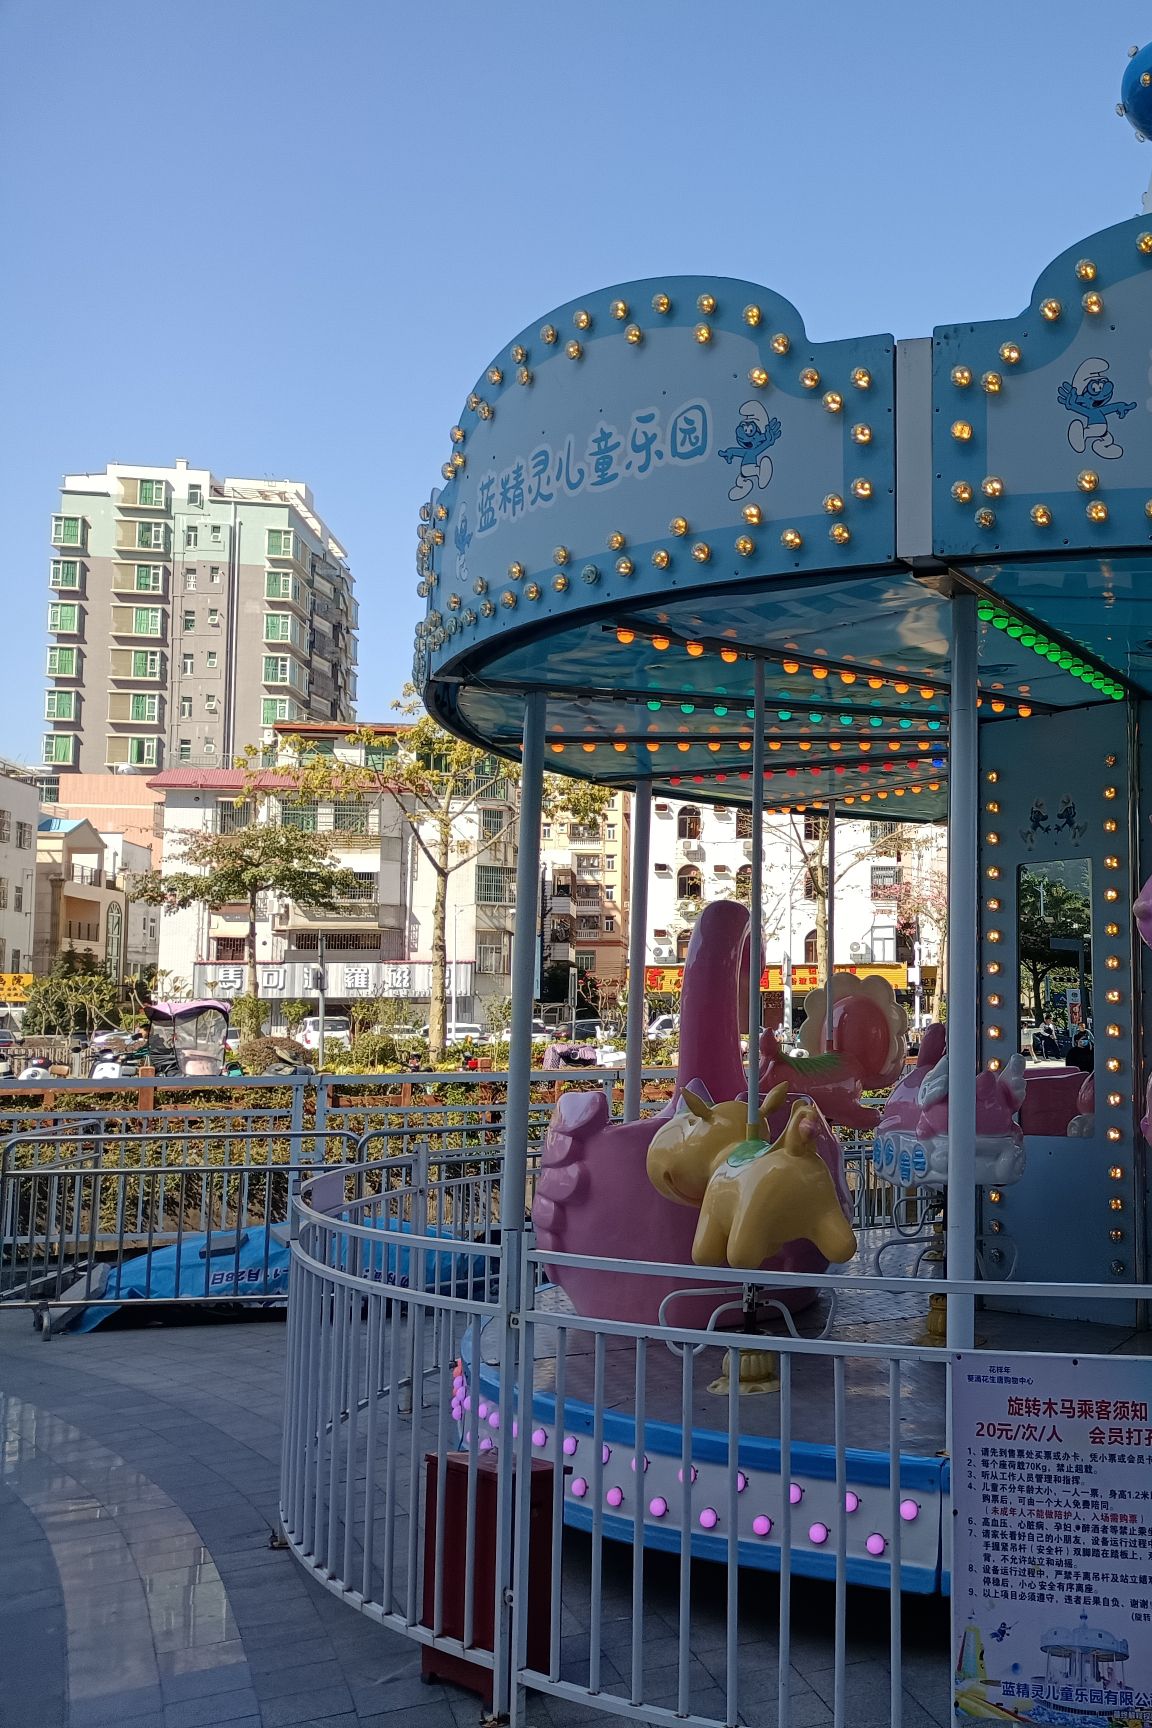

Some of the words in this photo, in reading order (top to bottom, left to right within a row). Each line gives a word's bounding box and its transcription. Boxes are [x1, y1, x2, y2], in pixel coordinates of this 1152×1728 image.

[476, 403, 708, 534] 蓝精灵儿童乐园
[1007, 1396, 1148, 1421] 旋转木马乘客须知
[975, 1421, 1063, 1443] 20元/次/人
